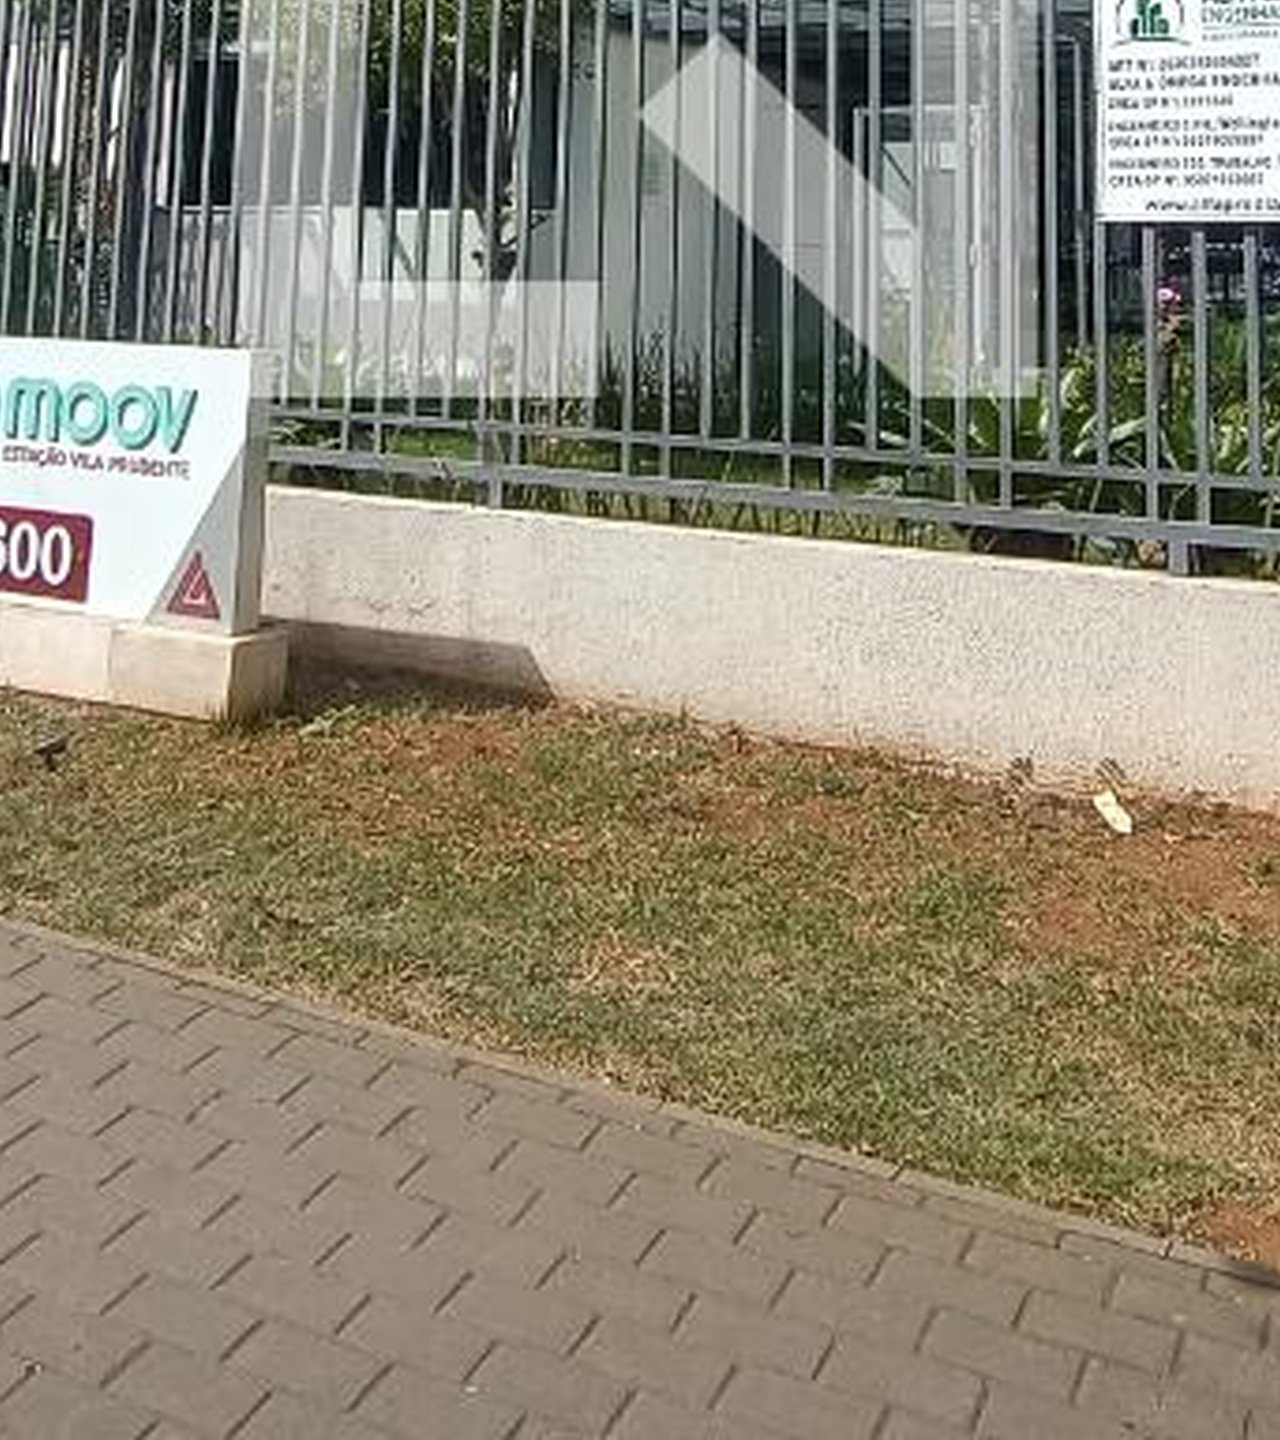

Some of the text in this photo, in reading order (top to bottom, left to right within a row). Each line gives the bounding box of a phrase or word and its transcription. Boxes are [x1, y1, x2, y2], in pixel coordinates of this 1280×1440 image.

[4, 375, 200, 454] moov
[1, 445, 67, 467] ESTAÇÃO
[69, 450, 104, 470] VILA
